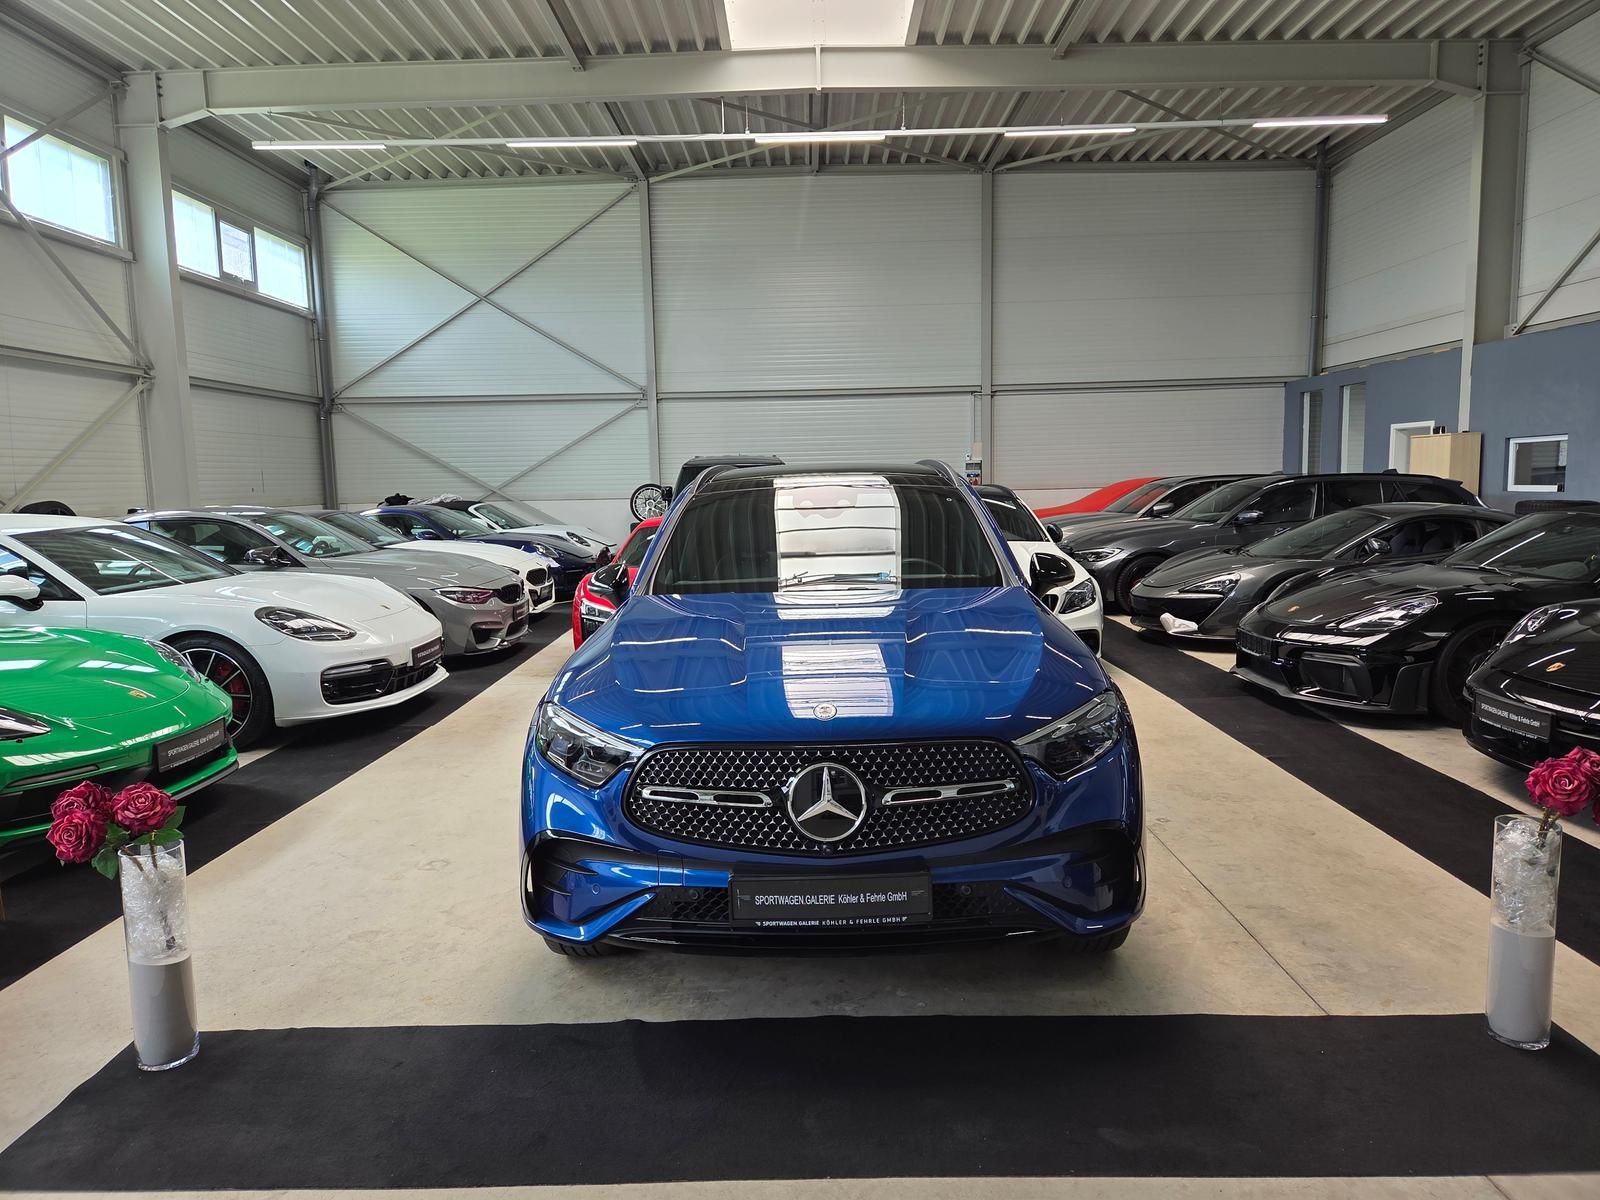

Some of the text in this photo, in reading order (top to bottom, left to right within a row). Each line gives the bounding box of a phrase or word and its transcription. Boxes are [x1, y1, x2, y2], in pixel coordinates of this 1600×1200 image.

[838, 893, 859, 904] Köhler
[859, 893, 865, 904] &
[866, 892, 886, 903] Fehrle
[887, 891, 908, 902] GmbH
